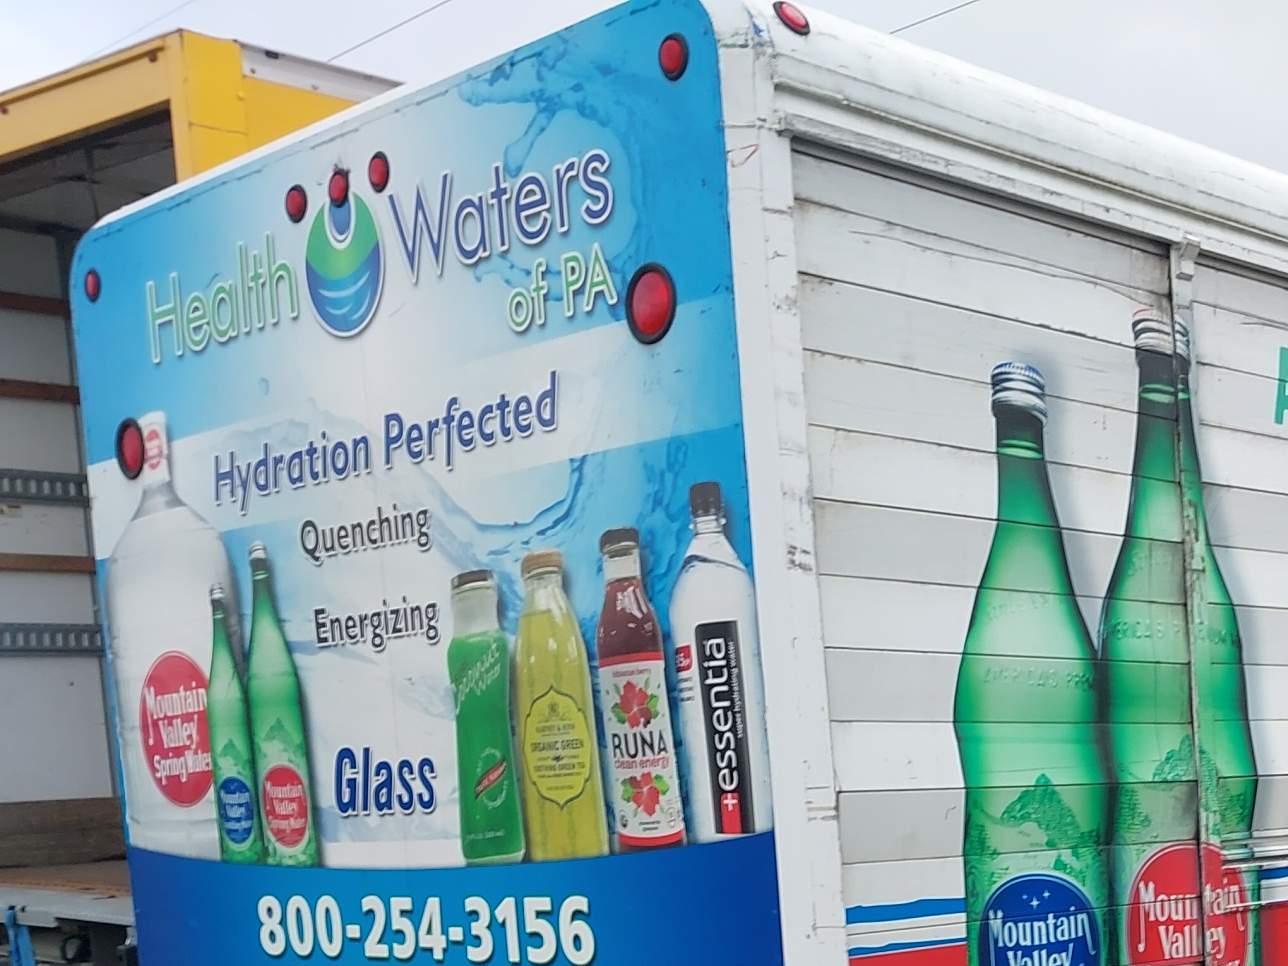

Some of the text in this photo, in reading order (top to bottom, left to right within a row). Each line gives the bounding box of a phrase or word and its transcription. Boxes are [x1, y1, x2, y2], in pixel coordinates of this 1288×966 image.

[144, 148, 615, 364] Health Waters
[507, 243, 618, 333] of PA
[213, 433, 371, 514] Hydration
[383, 371, 559, 470] Perfected
[300, 507, 432, 567] Quenching
[313, 599, 440, 652] Energizing
[144, 682, 207, 745] Mountain
[159, 714, 198, 750] Valley
[702, 637, 739, 791] essentia
[154, 752, 187, 785] Spring
[561, 738, 584, 751] GREEN
[611, 731, 669, 759] RUNA
[614, 756, 670, 769] clean energy
[334, 746, 437, 817] Glass
[258, 894, 596, 966] 800-254-3156
[1137, 878, 1246, 953] Mountain
[1158, 925, 1226, 960] Valley
